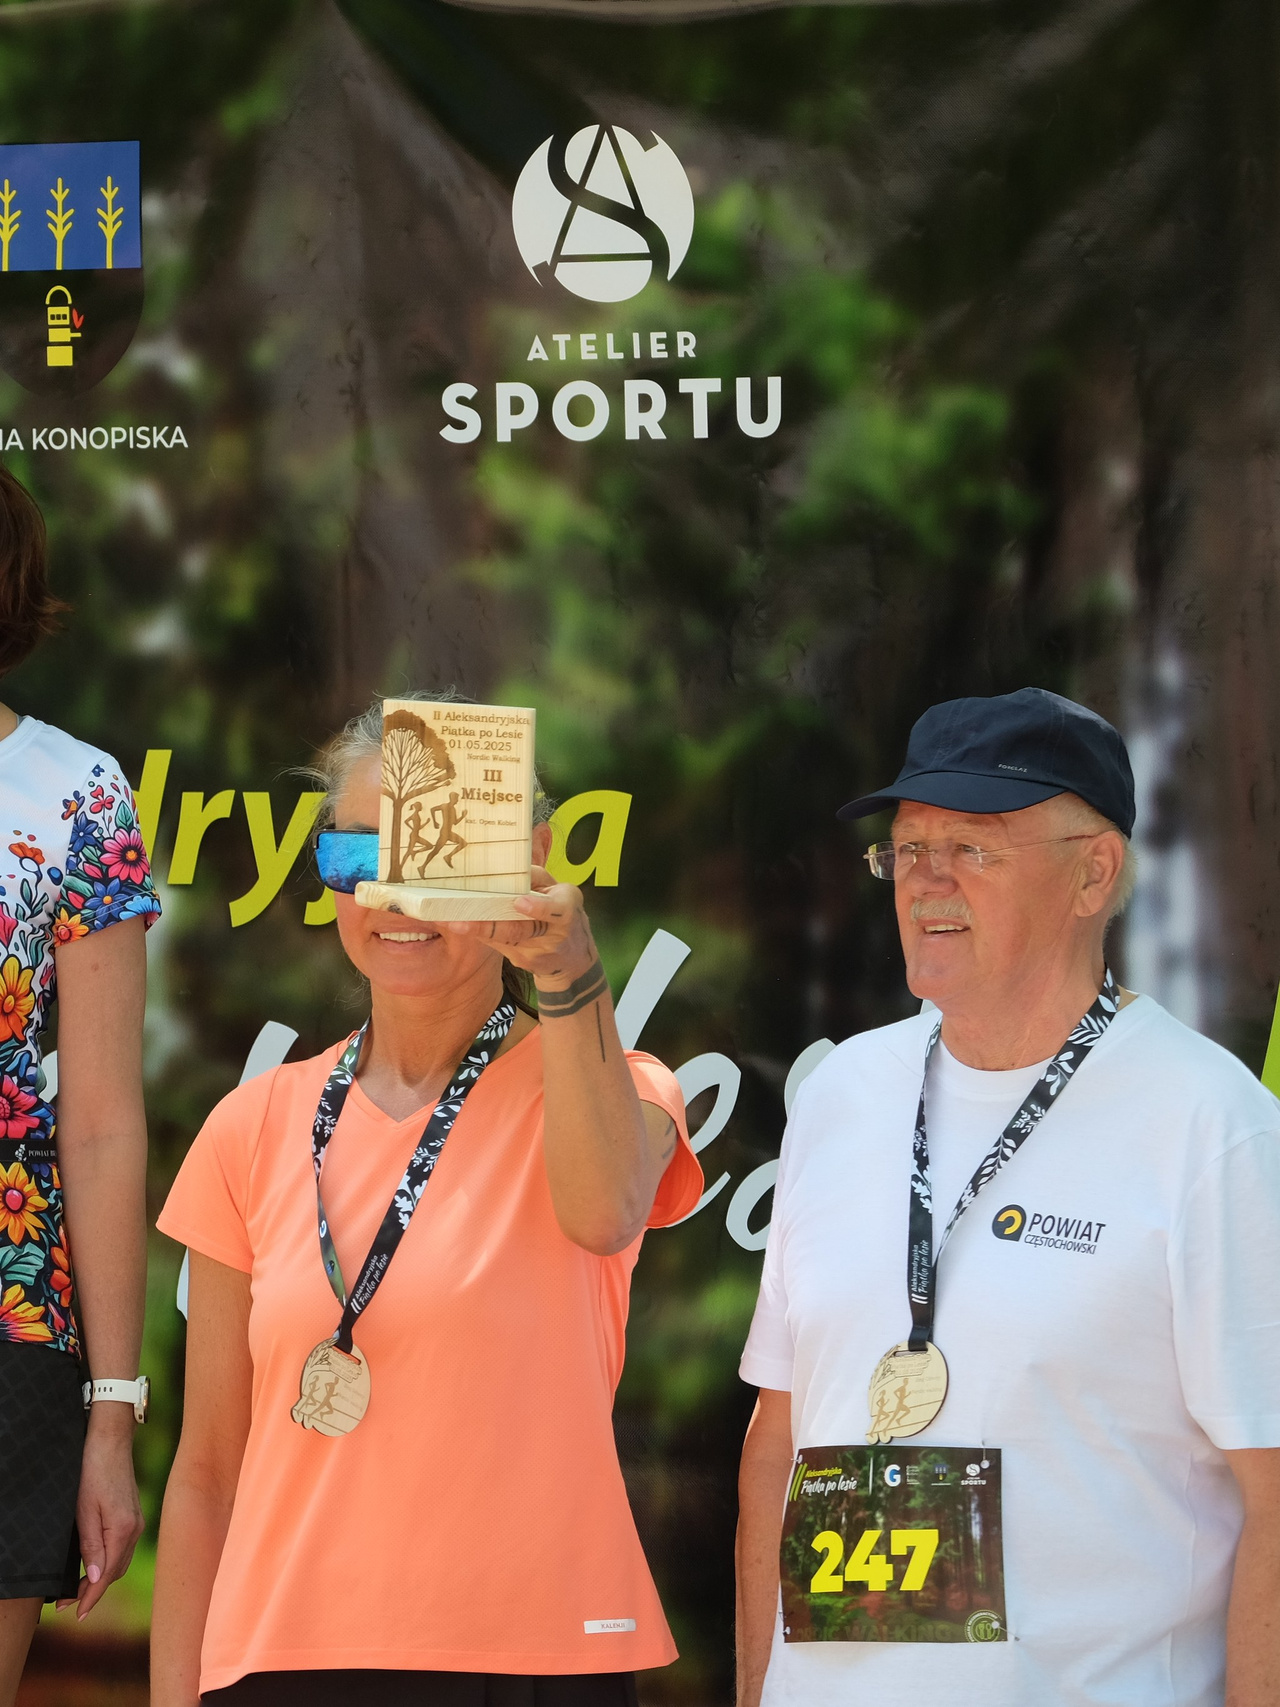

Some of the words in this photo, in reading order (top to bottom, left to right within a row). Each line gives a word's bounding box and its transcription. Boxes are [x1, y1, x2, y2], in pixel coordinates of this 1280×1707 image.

[527, 331, 697, 361] ATELIER
[439, 376, 782, 444] SPORTU
[32, 425, 189, 451] KONOPISKA
[433, 711, 441, 721] II
[444, 711, 530, 726] Aleksandryjska
[441, 725, 475, 737] Piątka
[479, 729, 493, 739] po
[496, 729, 523, 739] Lesie
[449, 739, 512, 751] 01.05.2025
[467, 753, 490, 761] Nordic
[492, 755, 521, 763] Walking
[483, 769, 502, 782] III
[461, 787, 523, 805] Miejsce
[1028, 1213, 1107, 1243] POWIAT
[1024, 1234, 1097, 1255] CZĘSTOCHOWSKI
[825, 1480, 837, 1497] po
[838, 1475, 857, 1491] lesie
[884, 1464, 901, 1487] G
[810, 1529, 939, 1593] 247
